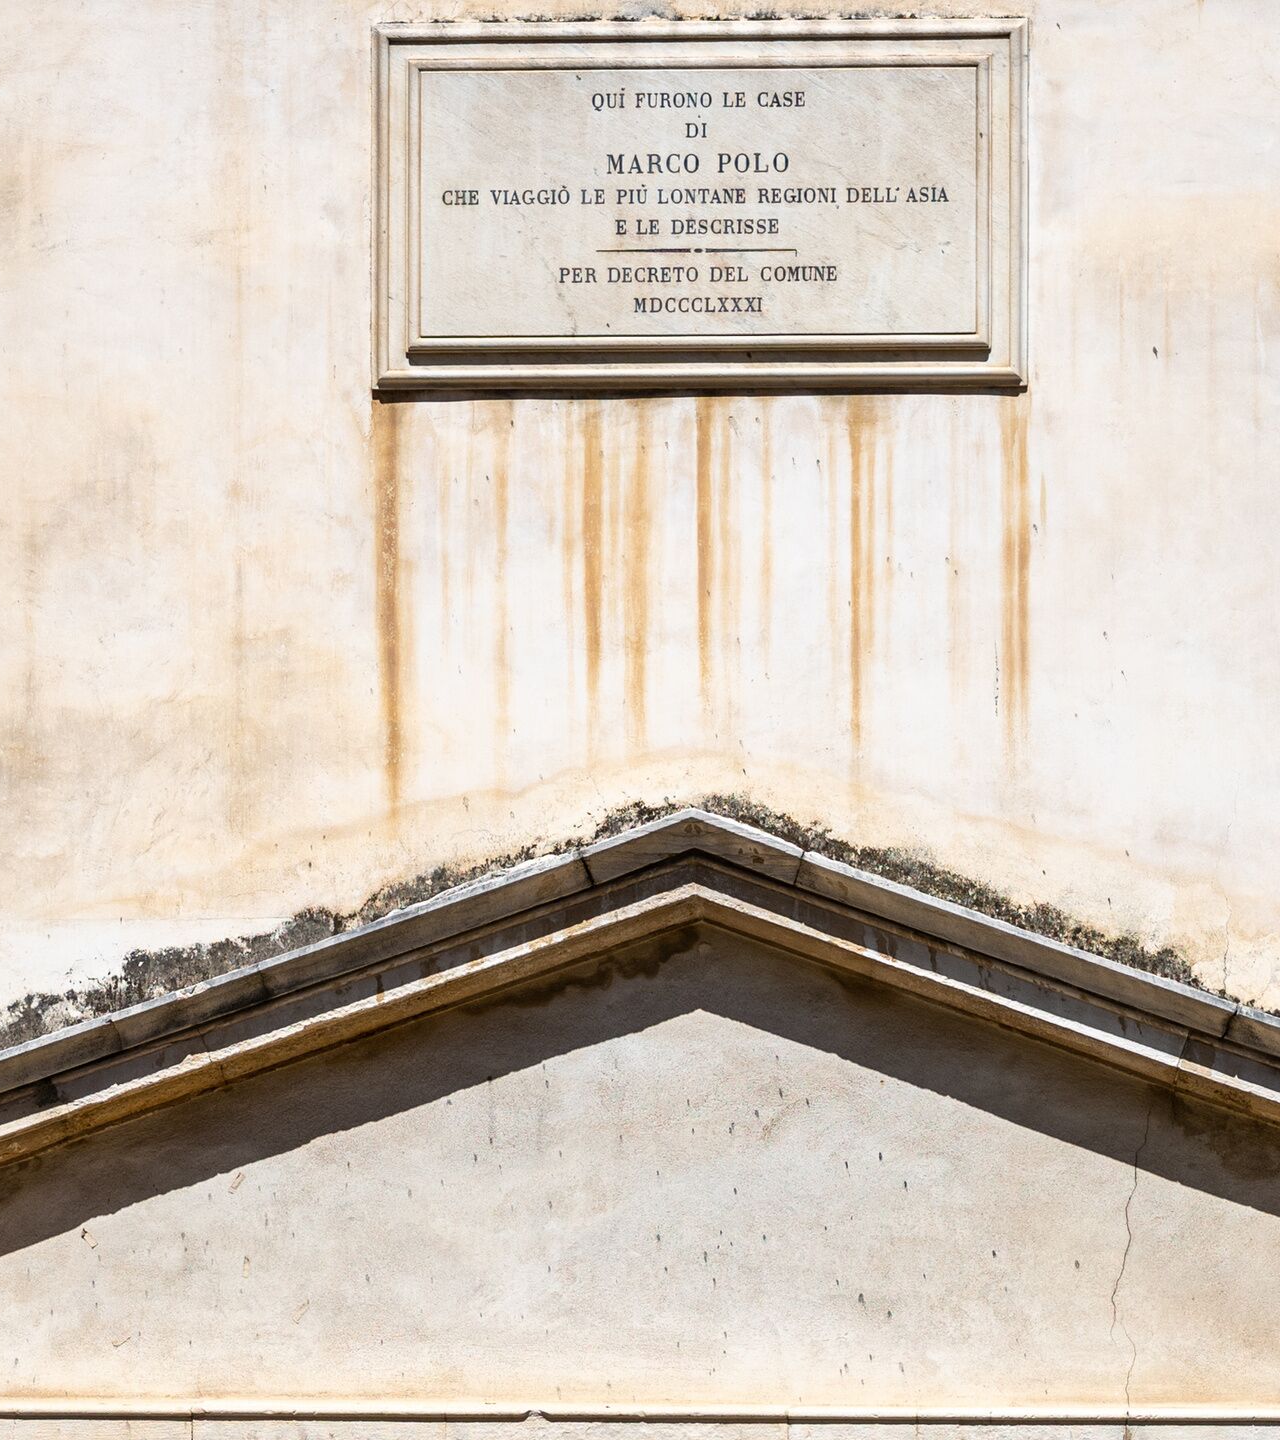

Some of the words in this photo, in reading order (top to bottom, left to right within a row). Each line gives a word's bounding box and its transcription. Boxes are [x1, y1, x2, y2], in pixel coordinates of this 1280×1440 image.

[635, 92, 712, 108] FURONO
[722, 91, 746, 107] LE
[757, 91, 806, 107] CASE
[685, 122, 708, 138] DI
[606, 153, 700, 174] MARCO
[717, 152, 789, 173] POLO
[442, 189, 479, 205] CHE
[490, 185, 570, 205] VIAGGIÒ
[581, 189, 605, 205] LE
[616, 184, 648, 204] PIÙ
[657, 188, 746, 204] LONTANE
[758, 187, 837, 204] REGIONI
[615, 219, 627, 235] E
[636, 219, 659, 235] LE
[670, 218, 779, 235] DESCRISSE
[559, 267, 597, 283] PER
[607, 266, 699, 283] DECRETO
[710, 266, 748, 282] DEL
[760, 265, 838, 282] COMUNE
[633, 297, 763, 313] MDCCCLXXXI
